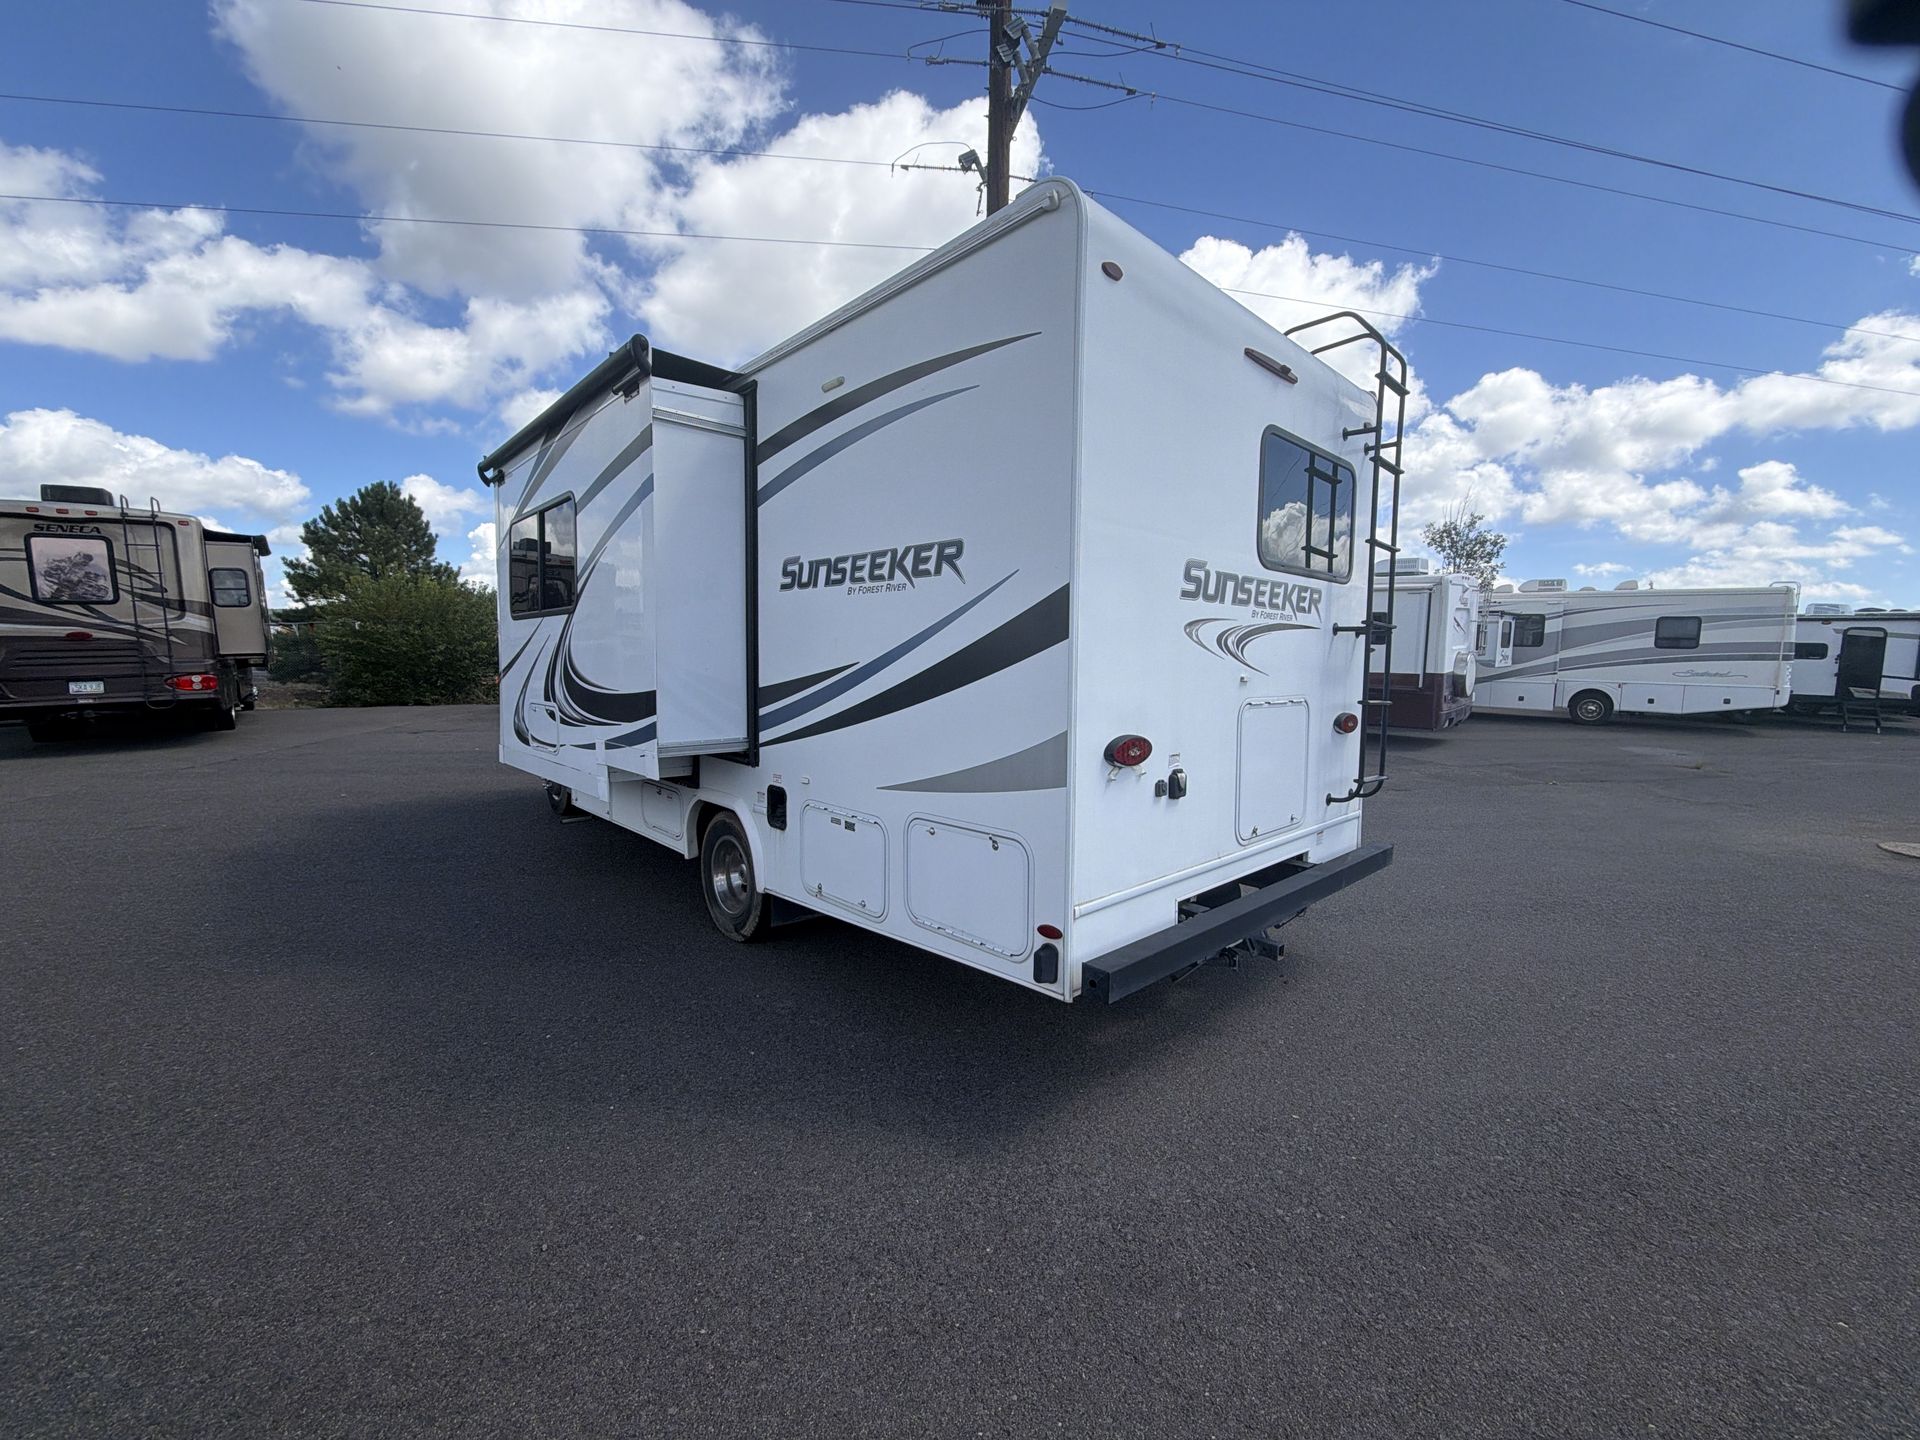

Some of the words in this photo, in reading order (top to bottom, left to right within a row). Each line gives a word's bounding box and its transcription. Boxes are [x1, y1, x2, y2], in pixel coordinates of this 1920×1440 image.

[34, 523, 102, 534] SENECA
[779, 538, 966, 591] SUNSEEKER
[847, 586, 857, 596] BY
[858, 584, 884, 595] FOREST
[885, 582, 907, 593] RIVER
[1179, 558, 1323, 624] SUNSEEKER
[1251, 609, 1259, 619] BY
[1260, 610, 1279, 621] FOREST
[1279, 612, 1294, 621] RIVER
